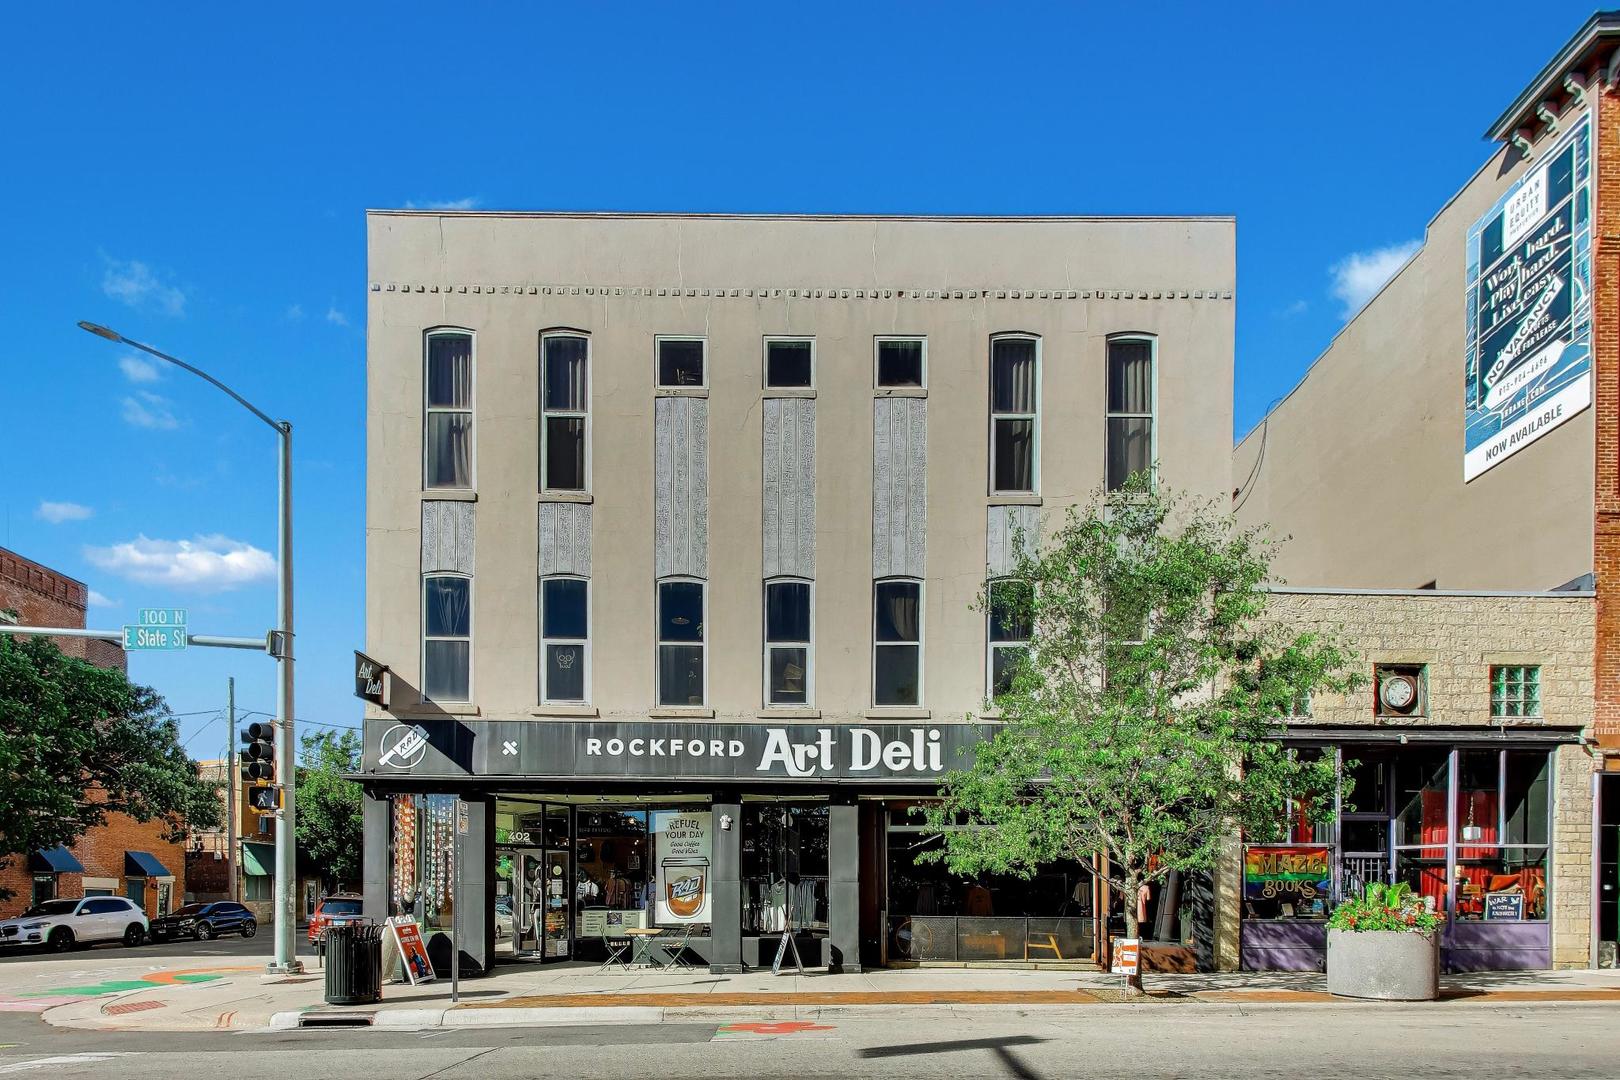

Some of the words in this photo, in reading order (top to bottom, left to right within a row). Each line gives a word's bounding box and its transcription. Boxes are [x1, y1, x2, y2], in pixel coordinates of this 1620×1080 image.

[1487, 359, 1505, 385] NO
[1505, 282, 1557, 356] VACANCY
[1535, 320, 1557, 342] LEASE
[1486, 439, 1507, 462] NOW
[1509, 404, 1562, 447] AVAILABLE
[143, 610, 167, 624] 100
[174, 610, 183, 624] N
[124, 628, 132, 646] E
[137, 629, 167, 647] State
[173, 629, 185, 647] St
[358, 662, 374, 679] Art
[365, 679, 382, 695] Deli
[400, 731, 419, 753] RAD
[586, 738, 745, 758] ROCKFORD
[756, 728, 837, 777] Art
[848, 728, 944, 773] Deli
[669, 819, 700, 830] REFUEL
[508, 832, 530, 842] 402
[665, 831, 687, 839] YOUR
[689, 831, 705, 839] DAY
[1258, 853, 1322, 875] MAZE
[671, 876, 702, 899] RAD
[1262, 880, 1317, 899] BOOKS
[1488, 896, 1508, 906] WAR
